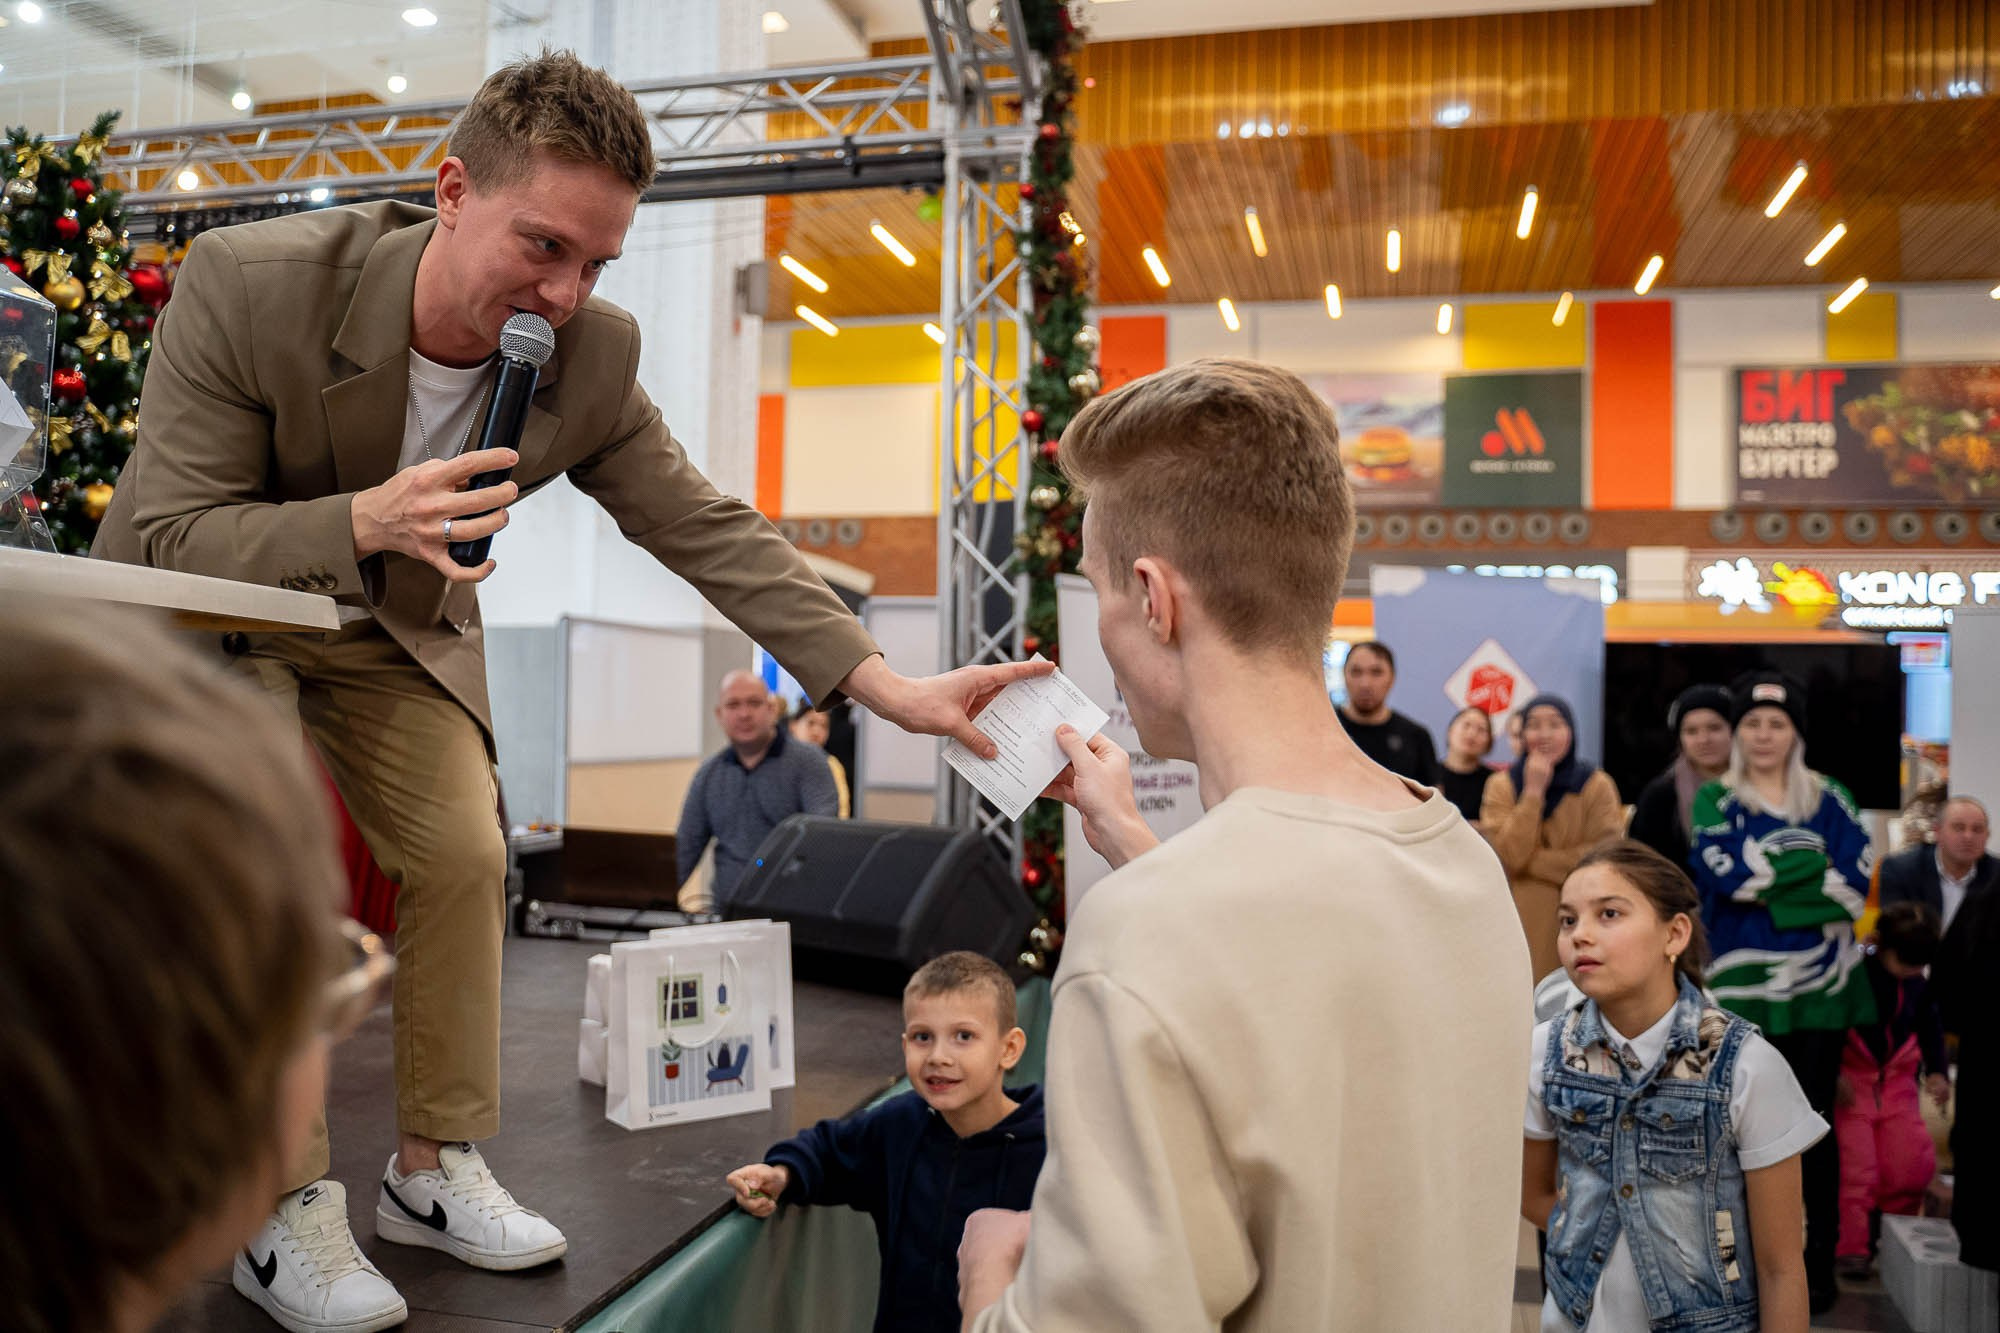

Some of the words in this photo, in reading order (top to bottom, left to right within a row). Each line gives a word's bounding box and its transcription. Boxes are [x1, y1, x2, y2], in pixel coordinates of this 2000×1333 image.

[1742, 369, 1846, 422] БИГ
[1740, 448, 1839, 479] БУРГЕР
[1839, 571, 1966, 604] KONG
